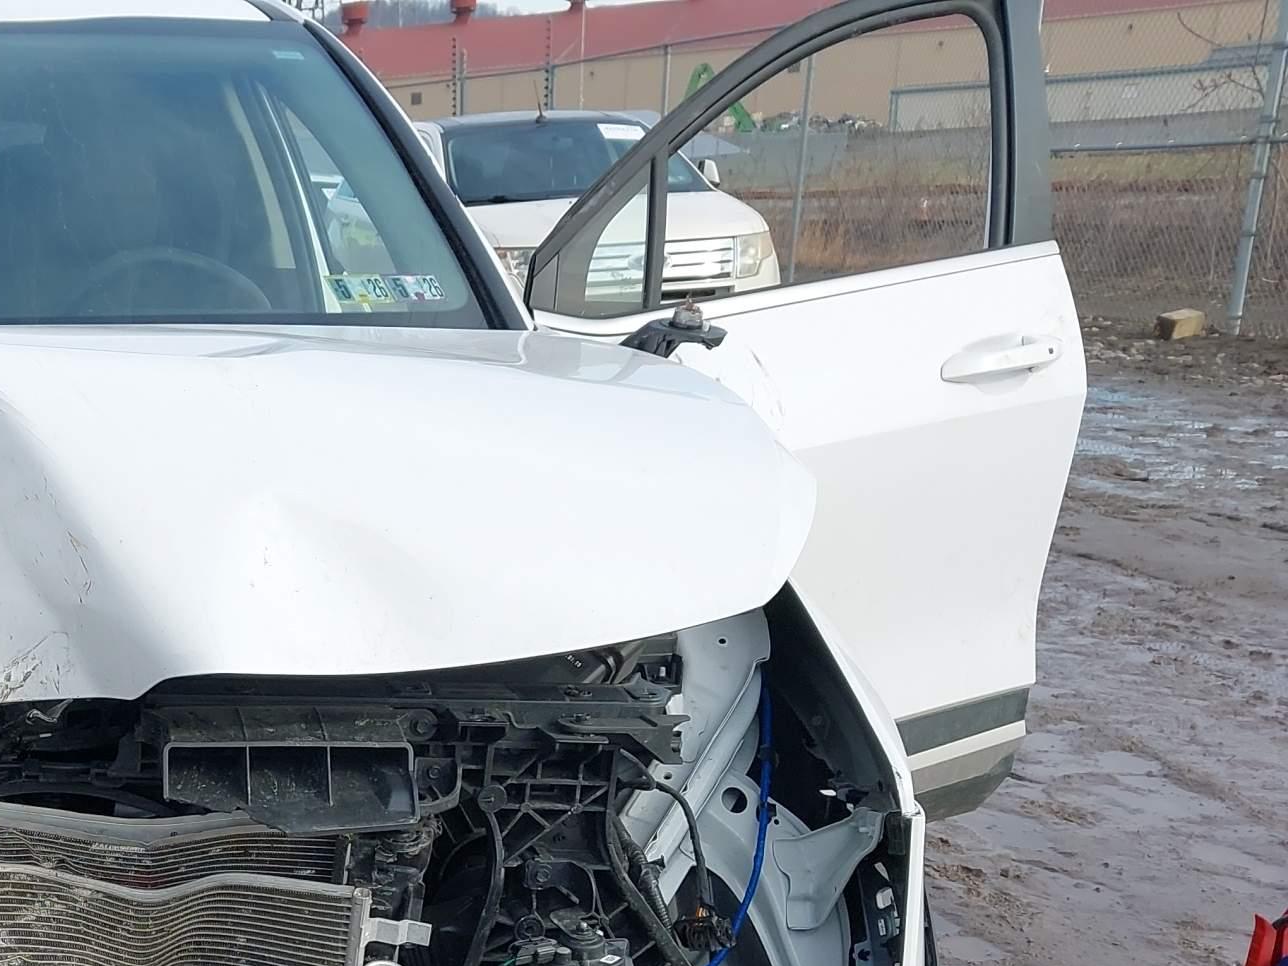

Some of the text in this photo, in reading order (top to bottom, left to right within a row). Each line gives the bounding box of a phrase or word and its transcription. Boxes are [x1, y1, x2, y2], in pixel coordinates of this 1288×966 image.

[335, 278, 389, 299] 5 26
[392, 277, 444, 298] 5 26
